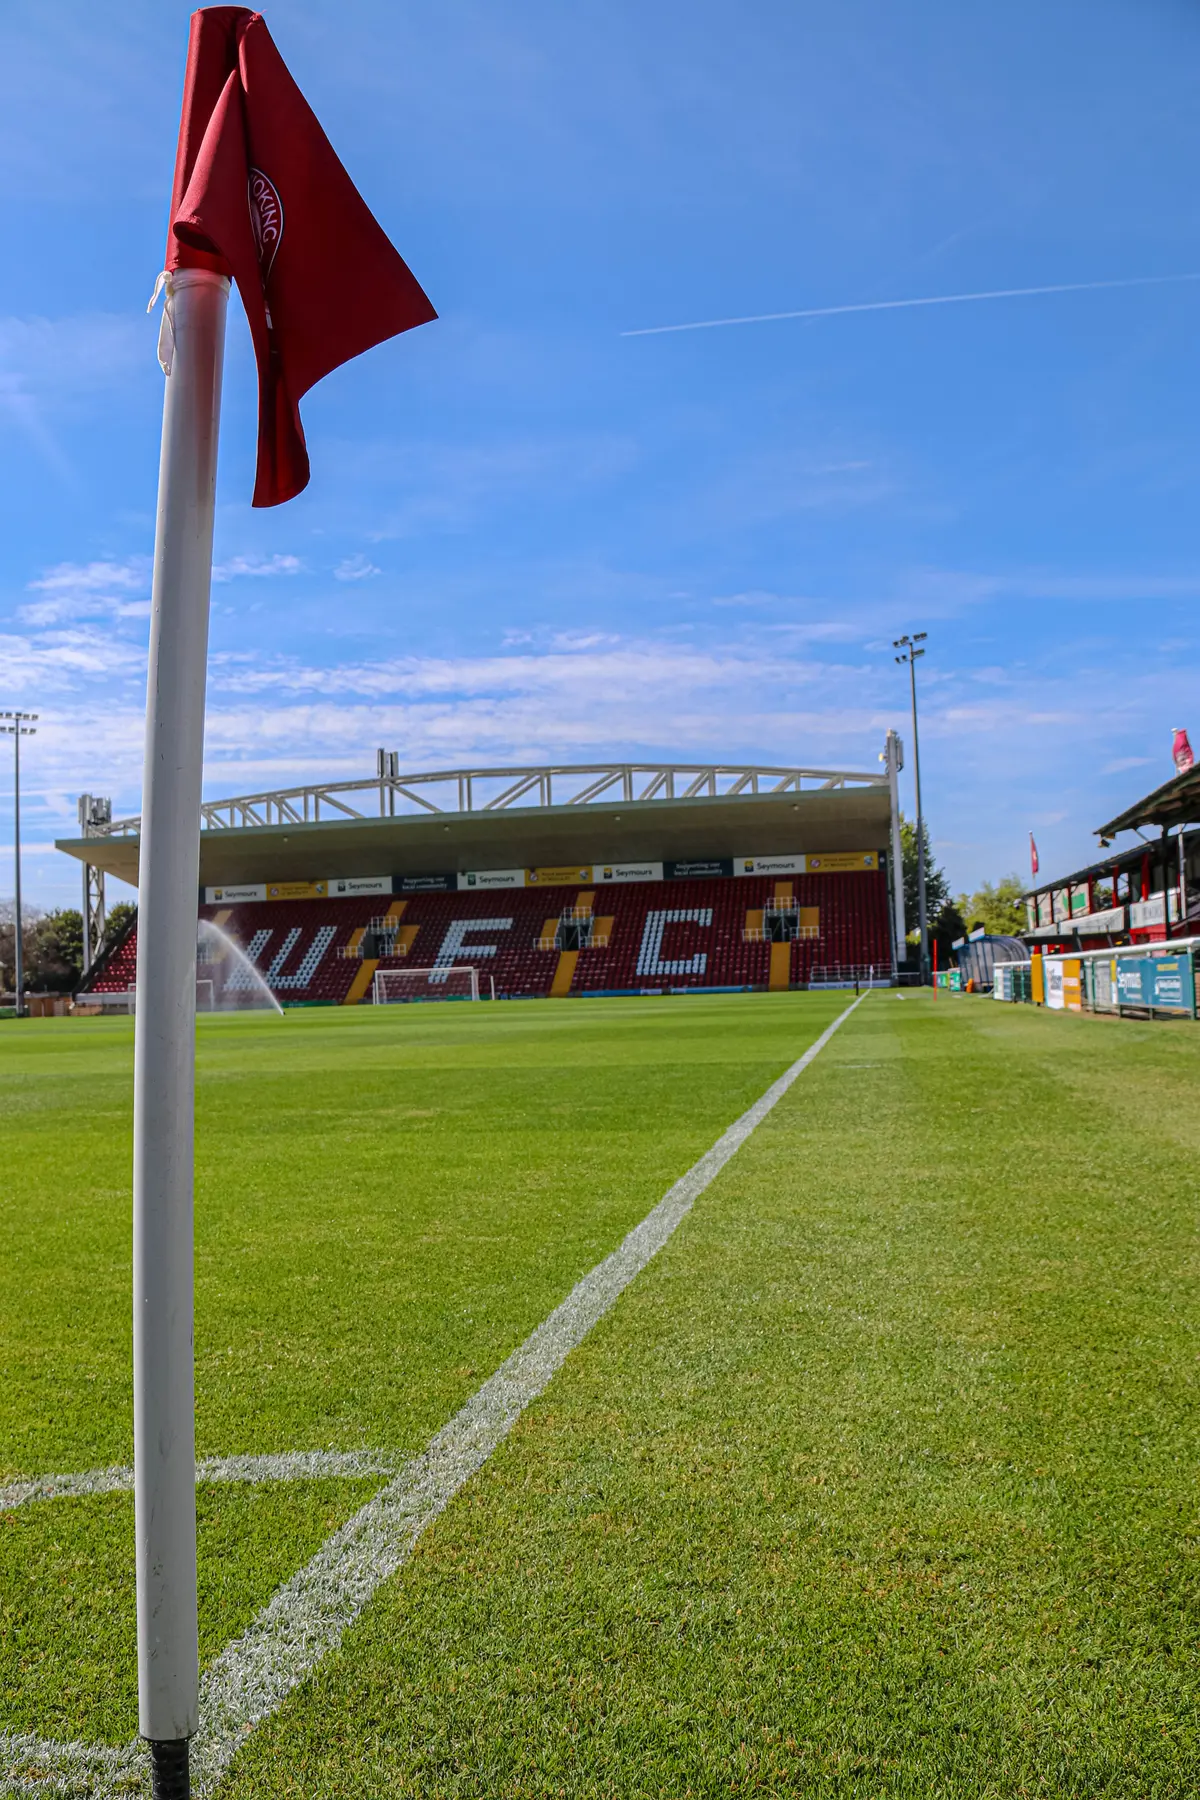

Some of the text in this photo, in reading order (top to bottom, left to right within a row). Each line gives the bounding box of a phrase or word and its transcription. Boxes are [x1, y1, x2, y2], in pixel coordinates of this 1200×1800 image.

[251, 175, 277, 243] OKING
[756, 861, 796, 871] Seymours
[615, 868, 653, 877] Seymours
[478, 875, 515, 884] Seymours
[347, 881, 383, 890] Seymours
[224, 889, 258, 898] Seymours
